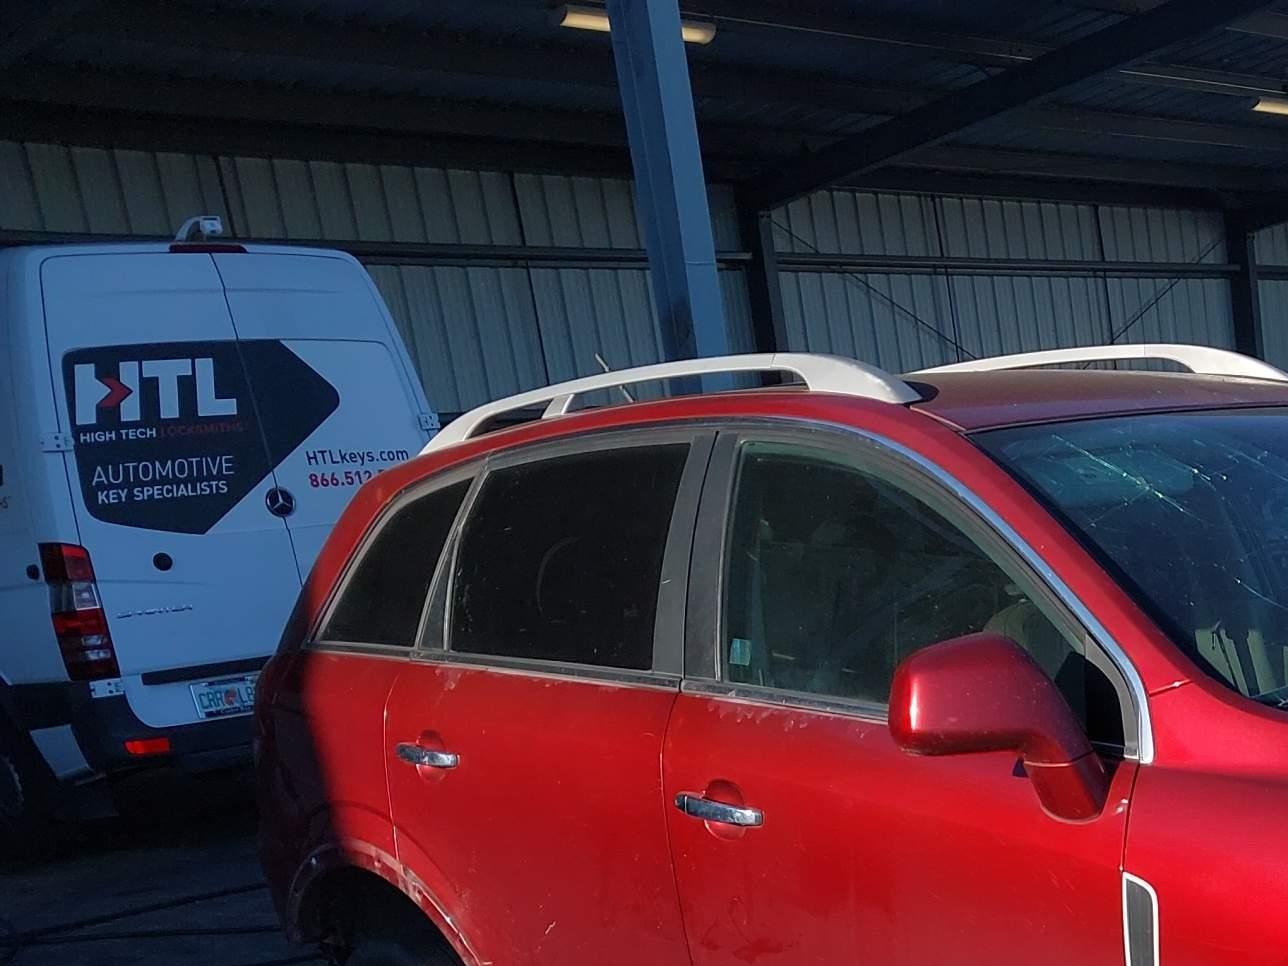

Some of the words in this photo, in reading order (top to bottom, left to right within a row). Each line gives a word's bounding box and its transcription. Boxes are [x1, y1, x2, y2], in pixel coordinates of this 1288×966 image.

[74, 357, 238, 425] HTL
[79, 431, 116, 444] HIGH
[120, 427, 157, 441] TECH
[305, 448, 409, 466] HTLkeys.com
[92, 455, 235, 487] AUTOMOTIVE
[97, 488, 129, 505] KEY
[133, 480, 229, 501] SPECIALISTS
